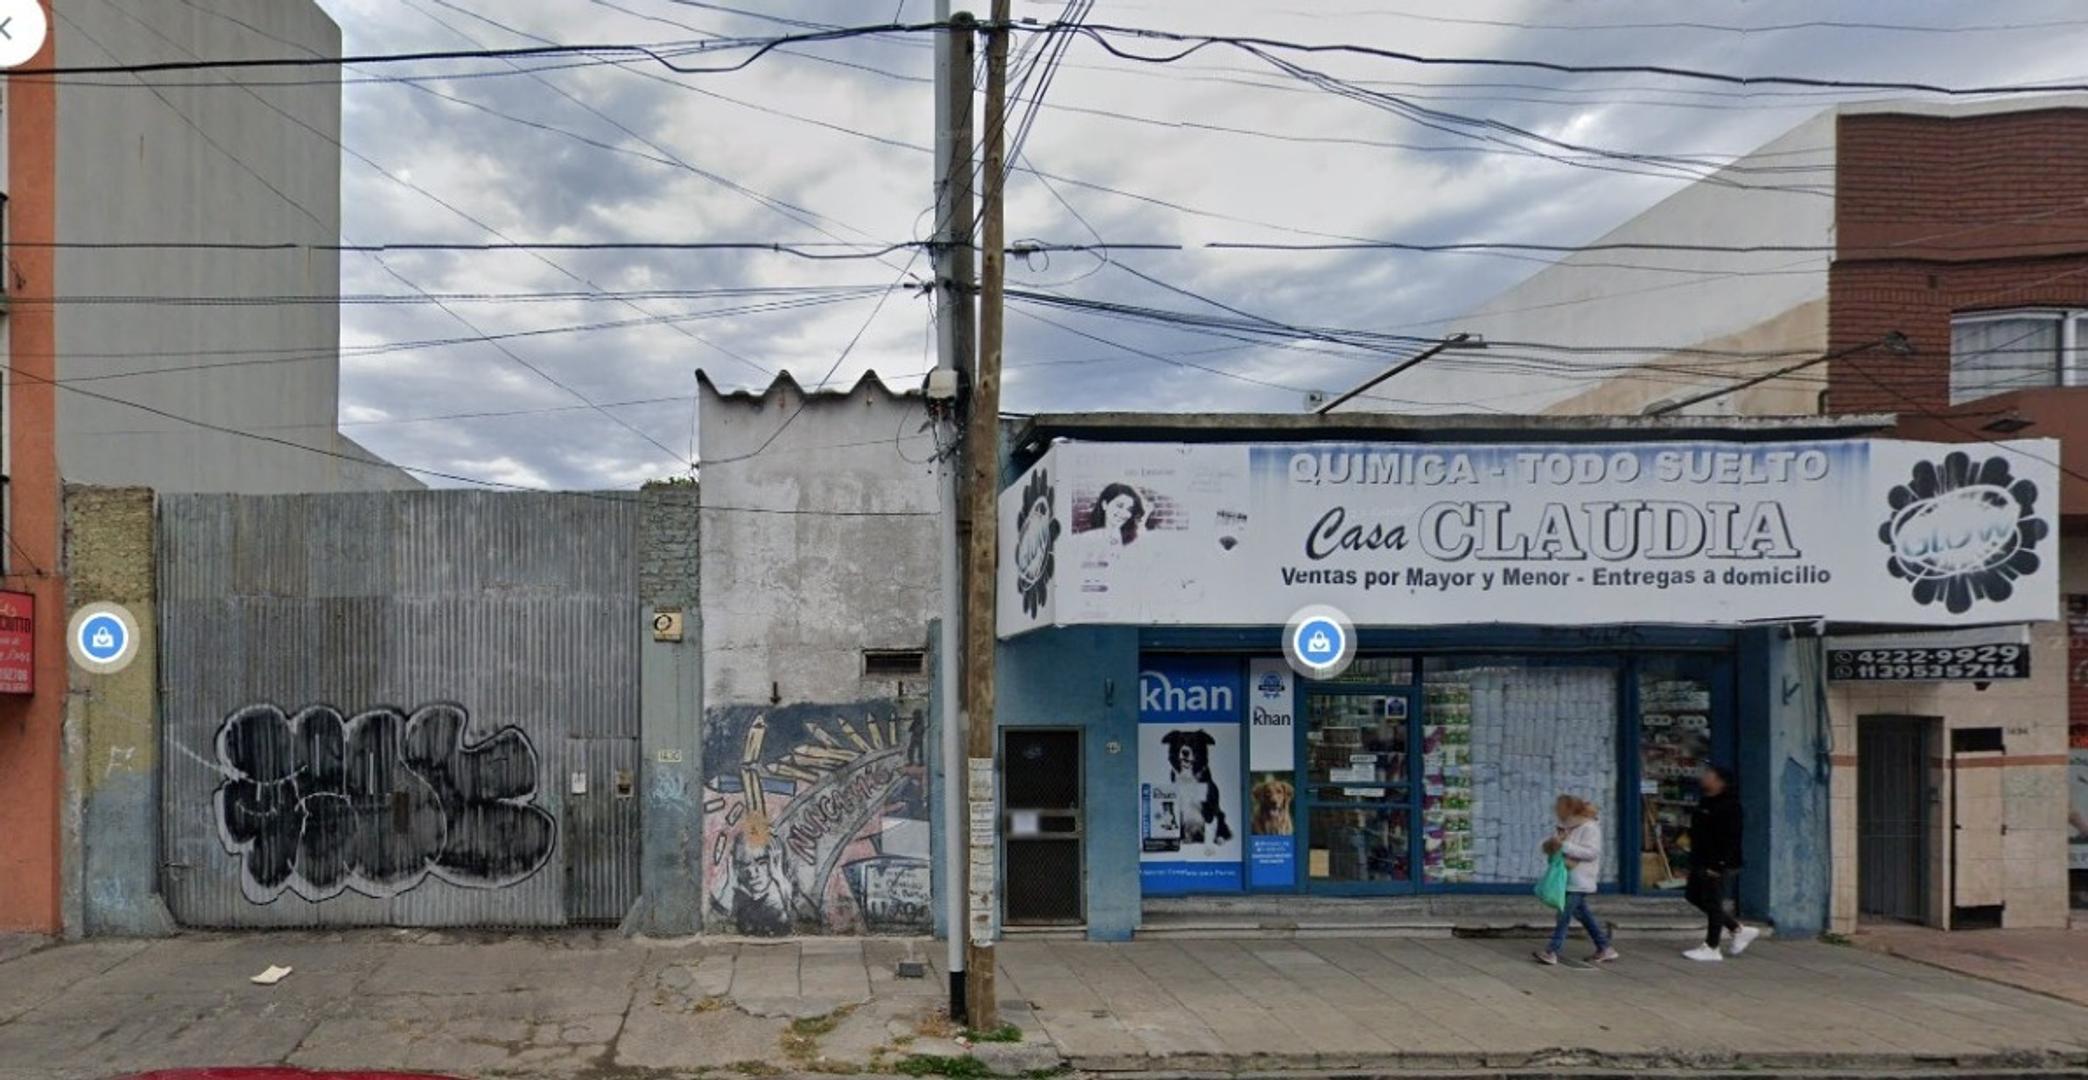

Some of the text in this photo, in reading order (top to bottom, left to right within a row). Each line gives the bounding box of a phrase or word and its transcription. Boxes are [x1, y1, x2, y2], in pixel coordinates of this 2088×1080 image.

[1288, 453, 1479, 487] QUIMICA
[1517, 452, 1641, 486] TODO
[1655, 449, 1830, 485] SUELTO
[1305, 500, 1802, 562] Casa CLAUDIA
[1281, 567, 1357, 586] Ventas
[1364, 572, 1399, 590] por
[1406, 568, 1475, 591] Mayor
[1482, 572, 1495, 591] y
[1503, 567, 1571, 586] Menor
[1592, 567, 1696, 589] Entregas
[1703, 570, 1716, 585] a
[1722, 565, 1832, 586] domicilio
[1140, 670, 1232, 711] khan
[1252, 706, 1291, 726] khan
